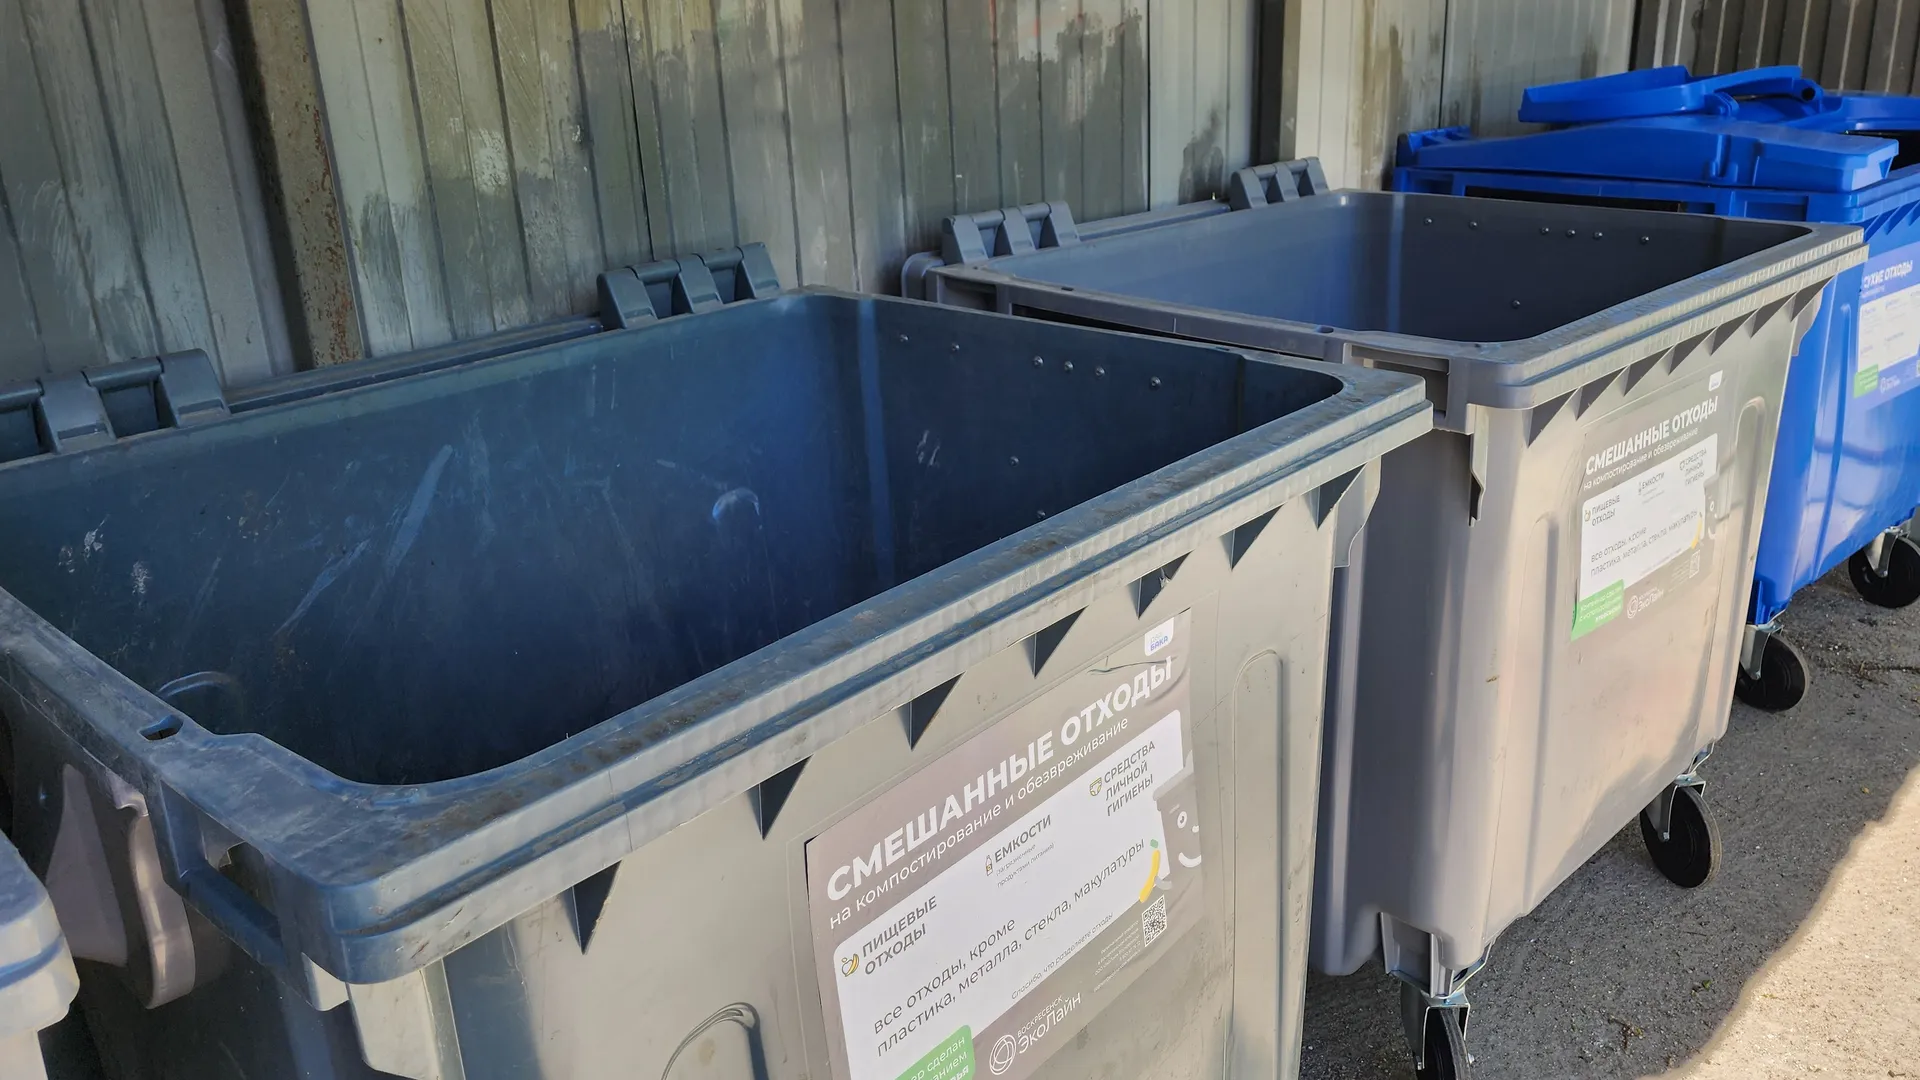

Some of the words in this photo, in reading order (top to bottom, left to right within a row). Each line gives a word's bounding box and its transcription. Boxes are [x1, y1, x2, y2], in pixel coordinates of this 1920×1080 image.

[1885, 259, 1913, 281] ОТХОДЫ
[1585, 420, 1669, 475] СМЕШАННЫЕ
[1672, 396, 1719, 433] ОТХОДЫ
[1583, 481, 1592, 491] на
[1593, 453, 1647, 487] компостирование
[1592, 495, 1620, 515] ПИЩЕВЫЕ
[1592, 508, 1616, 526] ОТХОДЫ
[827, 730, 1054, 901] СМЕШАННЫЕ
[1061, 656, 1172, 746] ОТХОДЫ
[1104, 741, 1155, 783] СРЕДСТВА
[1106, 760, 1148, 800] ЛИЧНОЙ
[1107, 774, 1153, 816] ГИГИЕНЫ
[830, 907, 852, 929] на
[856, 802, 1001, 912] компостирование
[1005, 795, 1014, 810] и
[1018, 718, 1129, 800] обезвреживание
[994, 814, 1051, 863] ЕМКОСТИ
[862, 895, 937, 957] ПИЩЕВЫЕ
[877, 991, 957, 1057] пластика,
[958, 941, 1022, 994] металла,
[1024, 900, 1072, 941] стекла,
[1074, 839, 1145, 902] макулатуры
[865, 923, 926, 975] ОТХОДЫ
[874, 1004, 902, 1035] все
[906, 956, 966, 1008] отходы,
[970, 918, 1015, 961] кроме
[1017, 995, 1063, 1036] ВОСКРЕСЕНСК
[1018, 992, 1082, 1054] ЭкоЛайн
[927, 1037, 965, 1071] сделан
